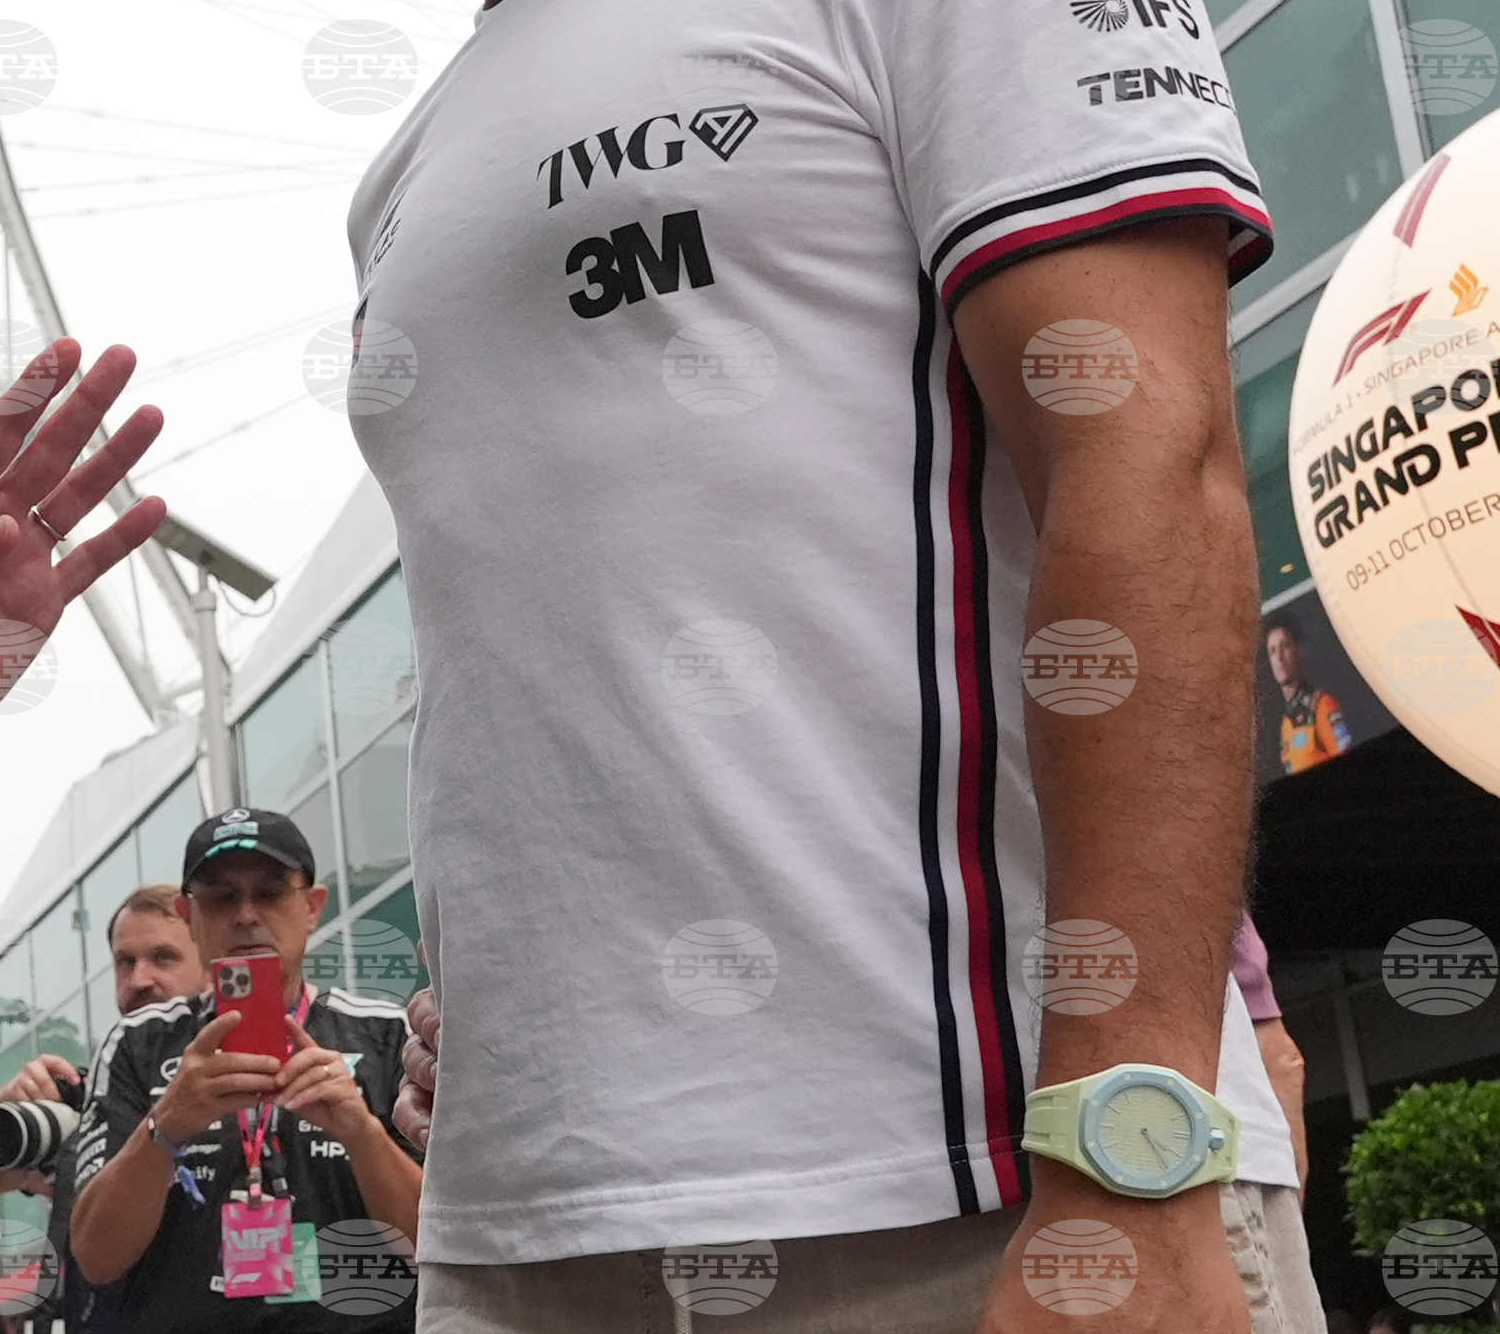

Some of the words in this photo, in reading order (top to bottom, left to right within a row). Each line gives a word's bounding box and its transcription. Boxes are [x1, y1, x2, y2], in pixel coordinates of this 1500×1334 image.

[565, 210, 715, 319] 3M
[1363, 328, 1479, 399] SINGAPORE
[1306, 358, 1500, 504] SINGAPO
[1314, 443, 1442, 549] GRAND
[1448, 412, 1500, 470] P
[1389, 492, 1500, 561] OCTOBER
